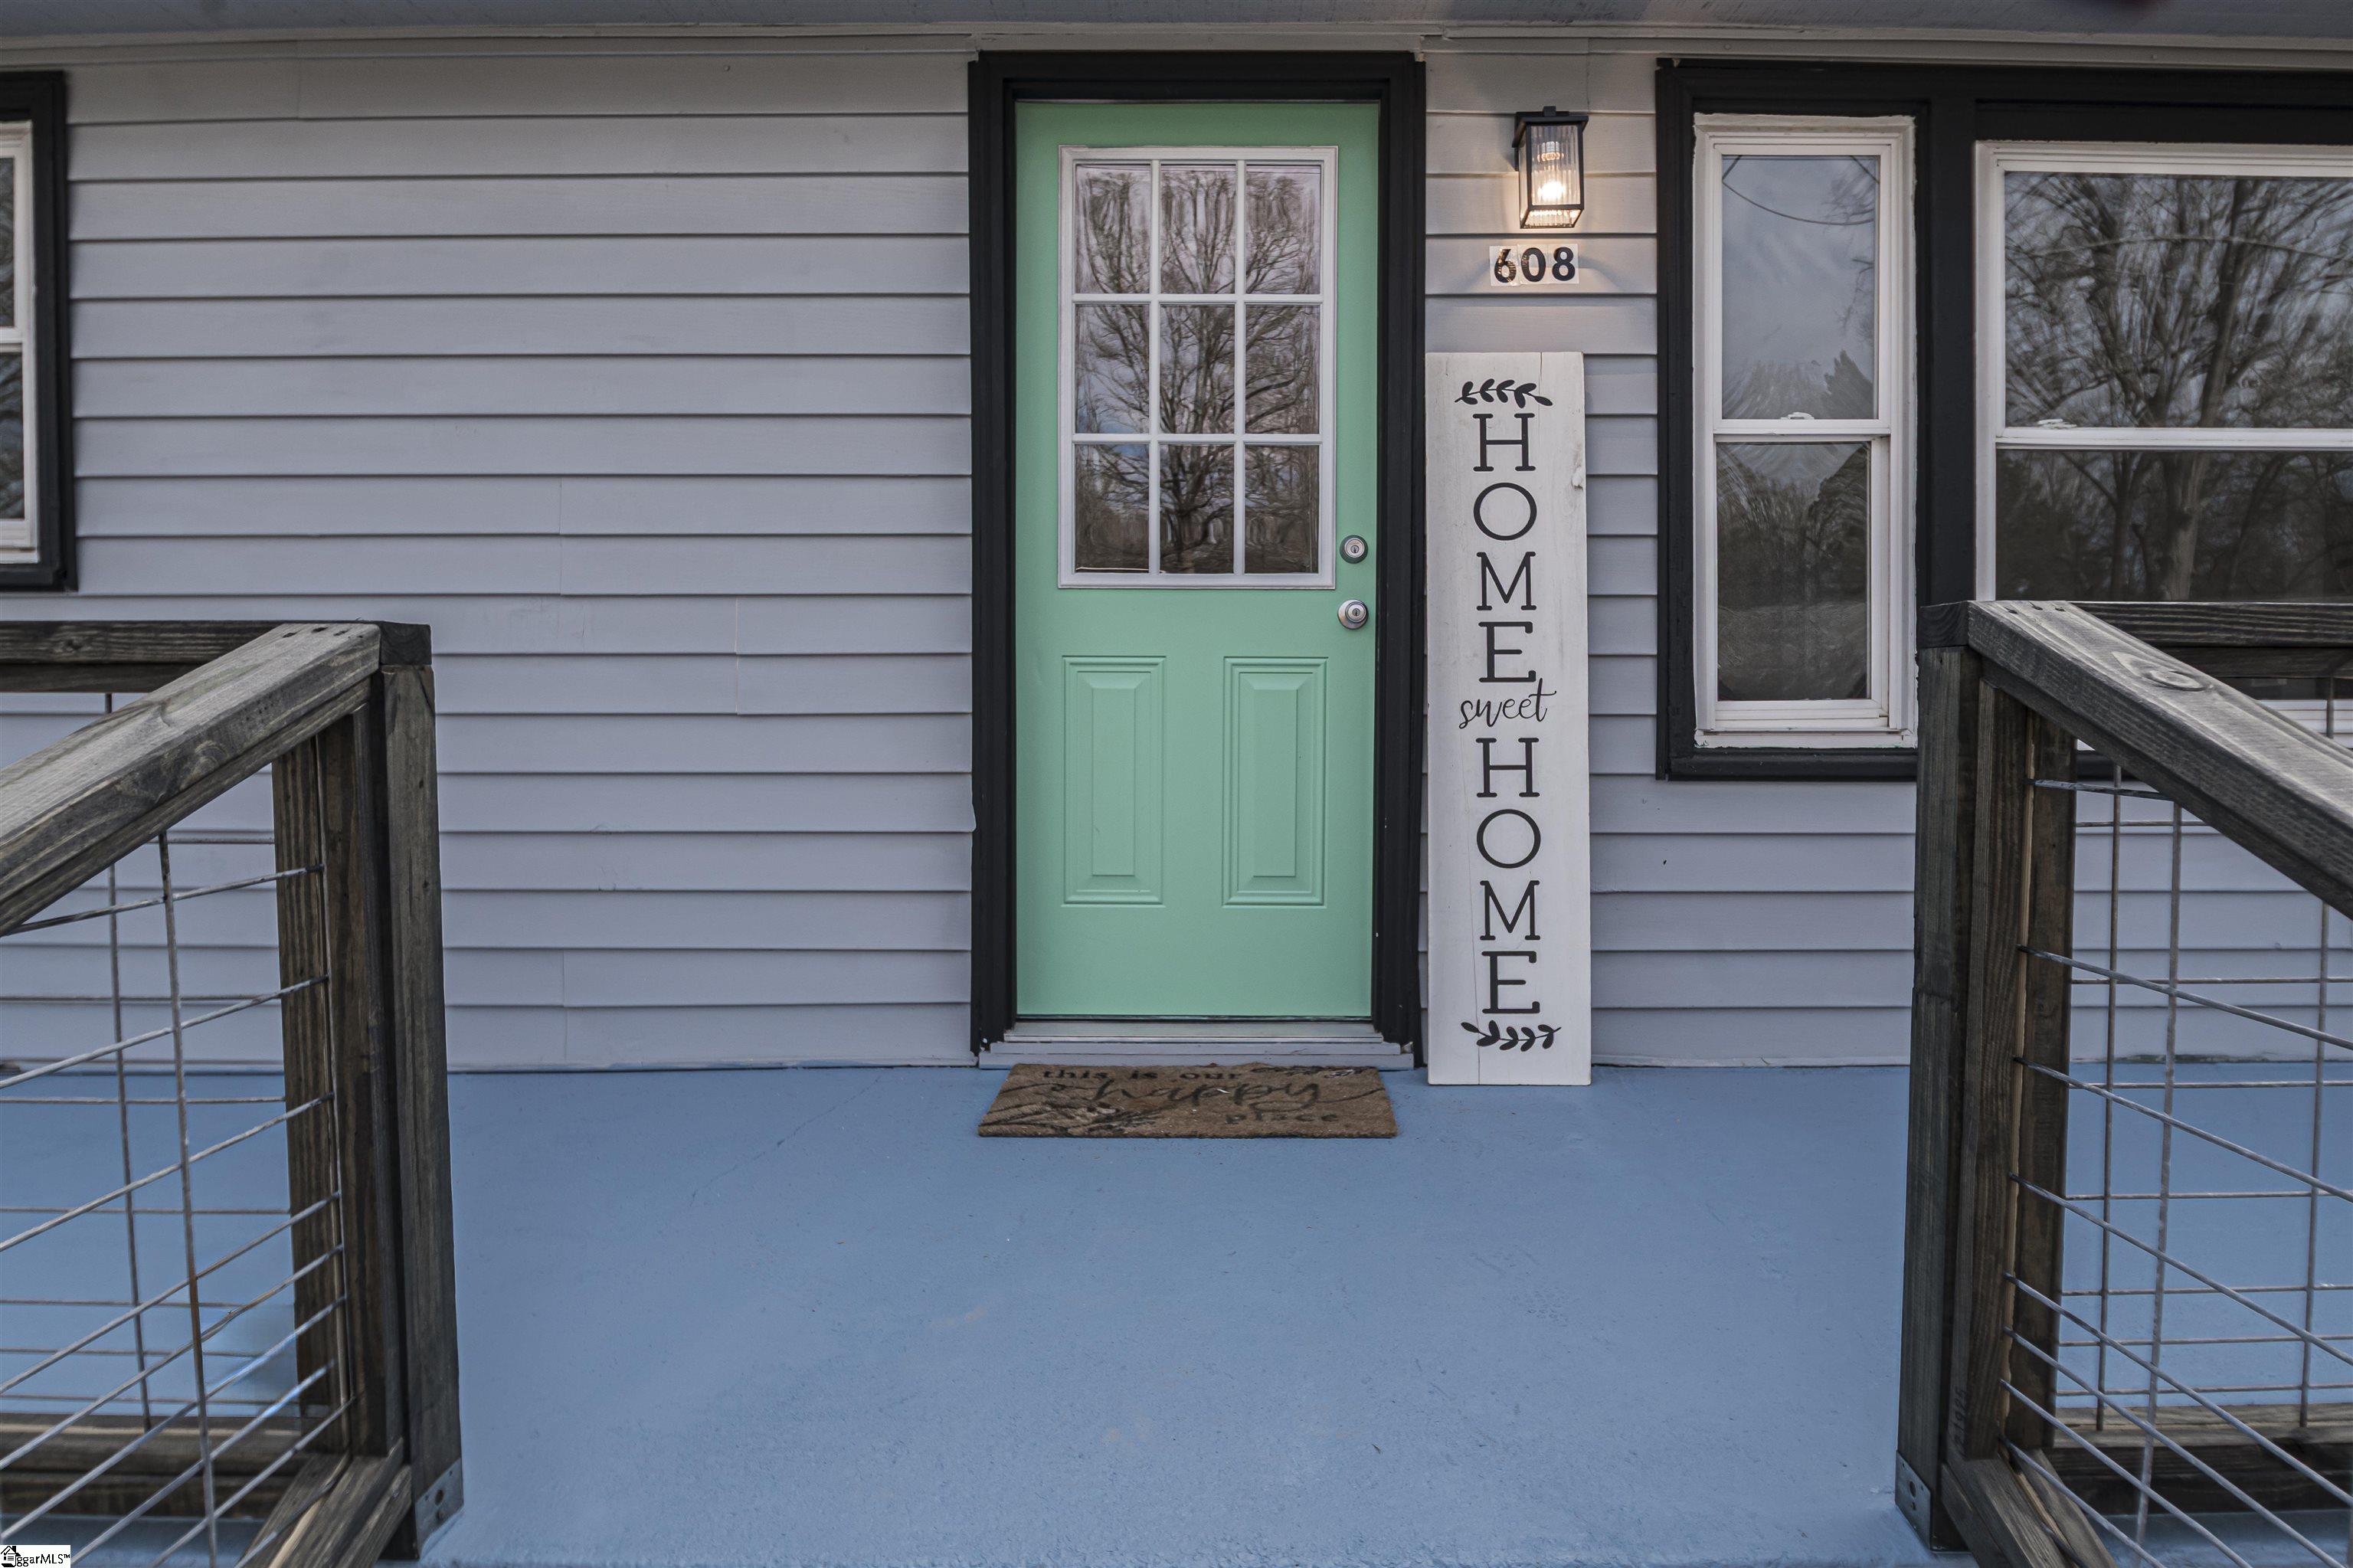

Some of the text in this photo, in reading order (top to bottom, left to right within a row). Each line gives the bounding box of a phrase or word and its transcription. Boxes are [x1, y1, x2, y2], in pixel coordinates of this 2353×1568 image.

[1494, 247, 1576, 283] 608
[1472, 413, 1537, 683] HOME
[1458, 678, 1557, 729] sweet
[1475, 737, 1541, 1014] HOME
[1043, 1069, 1108, 1079] this
[1130, 1070, 1158, 1079] is
[1085, 1079, 1331, 1113] happy
[1225, 1110, 1339, 1125] place
